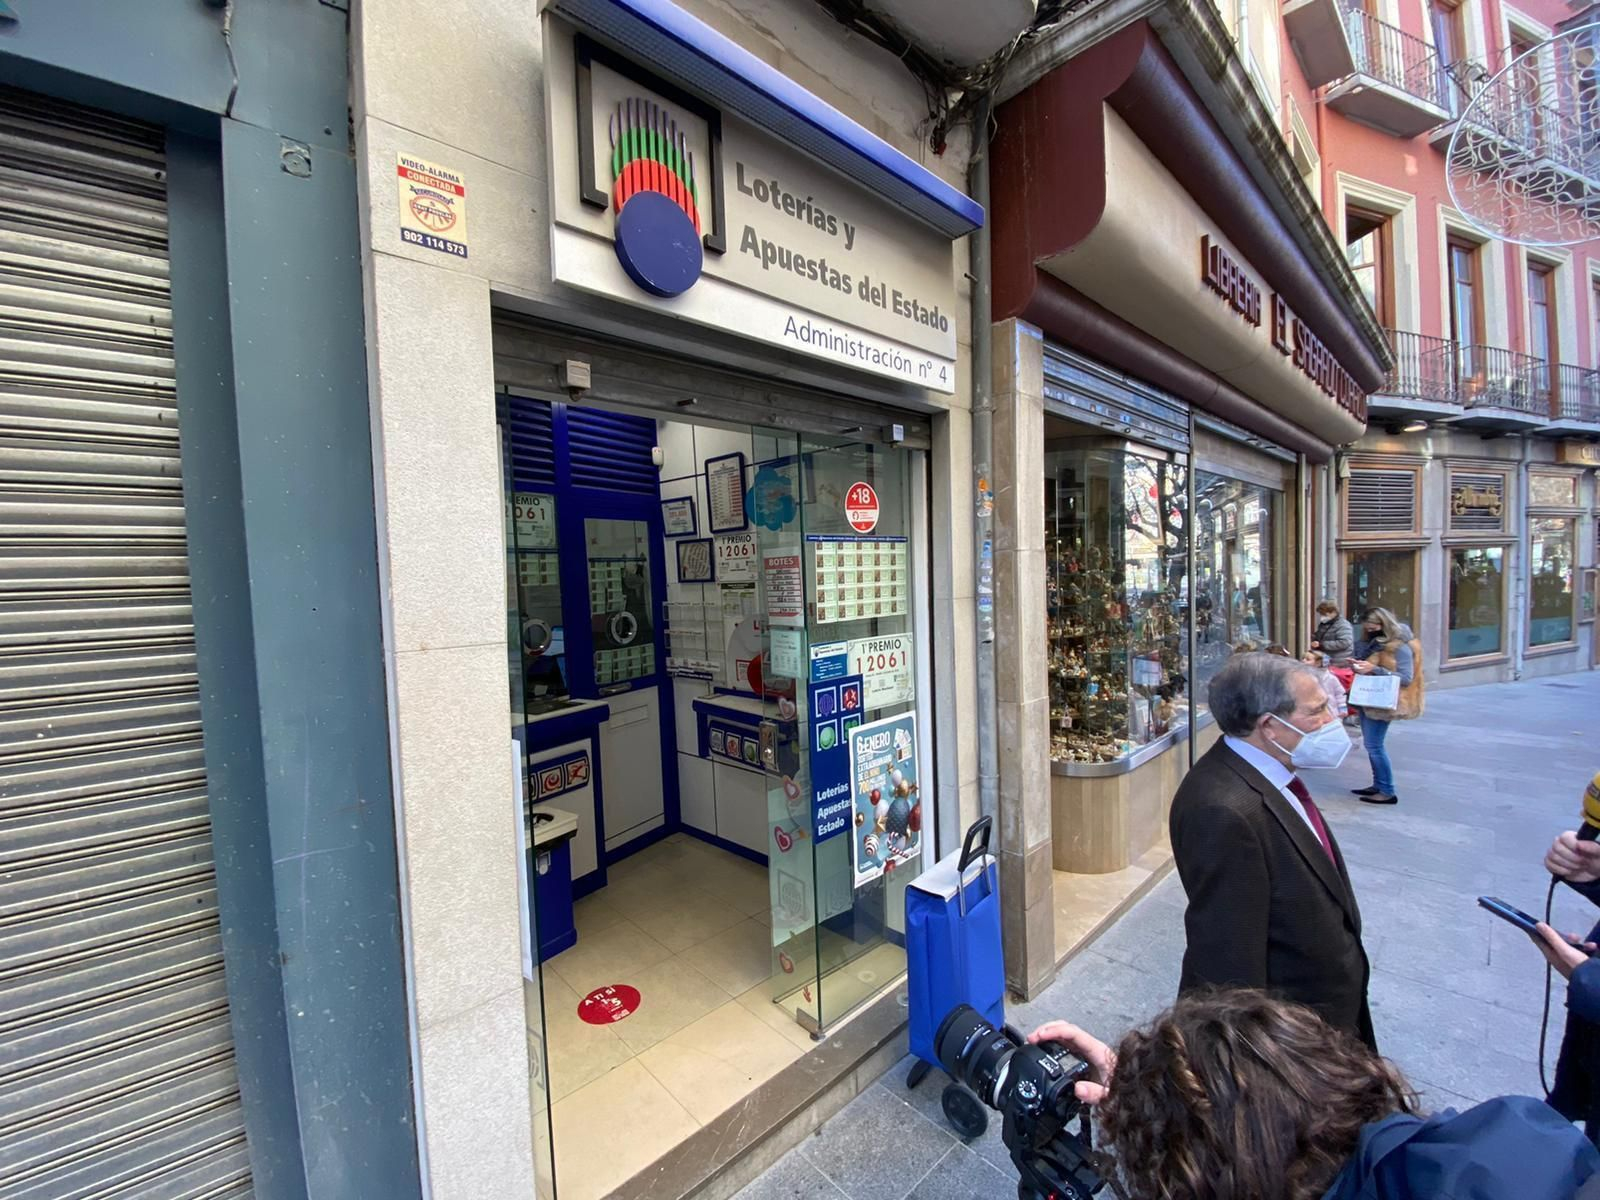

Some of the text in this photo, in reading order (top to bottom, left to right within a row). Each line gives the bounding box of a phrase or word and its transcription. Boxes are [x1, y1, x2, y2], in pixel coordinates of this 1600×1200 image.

[400, 157, 460, 184] VIDEO-ALARMA
[406, 170, 457, 194] CONECTADA
[735, 161, 856, 251] Loterías y
[403, 230, 465, 255] 902 114 573
[739, 224, 949, 333] Apuestas del Estado
[783, 315, 912, 375] Administración
[938, 365, 948, 384] 4
[851, 487, 871, 504] +18
[727, 534, 752, 544] PREMIO
[718, 543, 756, 557] 12061
[768, 557, 794, 567] BOTES
[868, 639, 902, 653] PREMIO
[856, 650, 906, 673] 12061
[816, 783, 849, 802] Loterías
[818, 817, 845, 837] Estado
